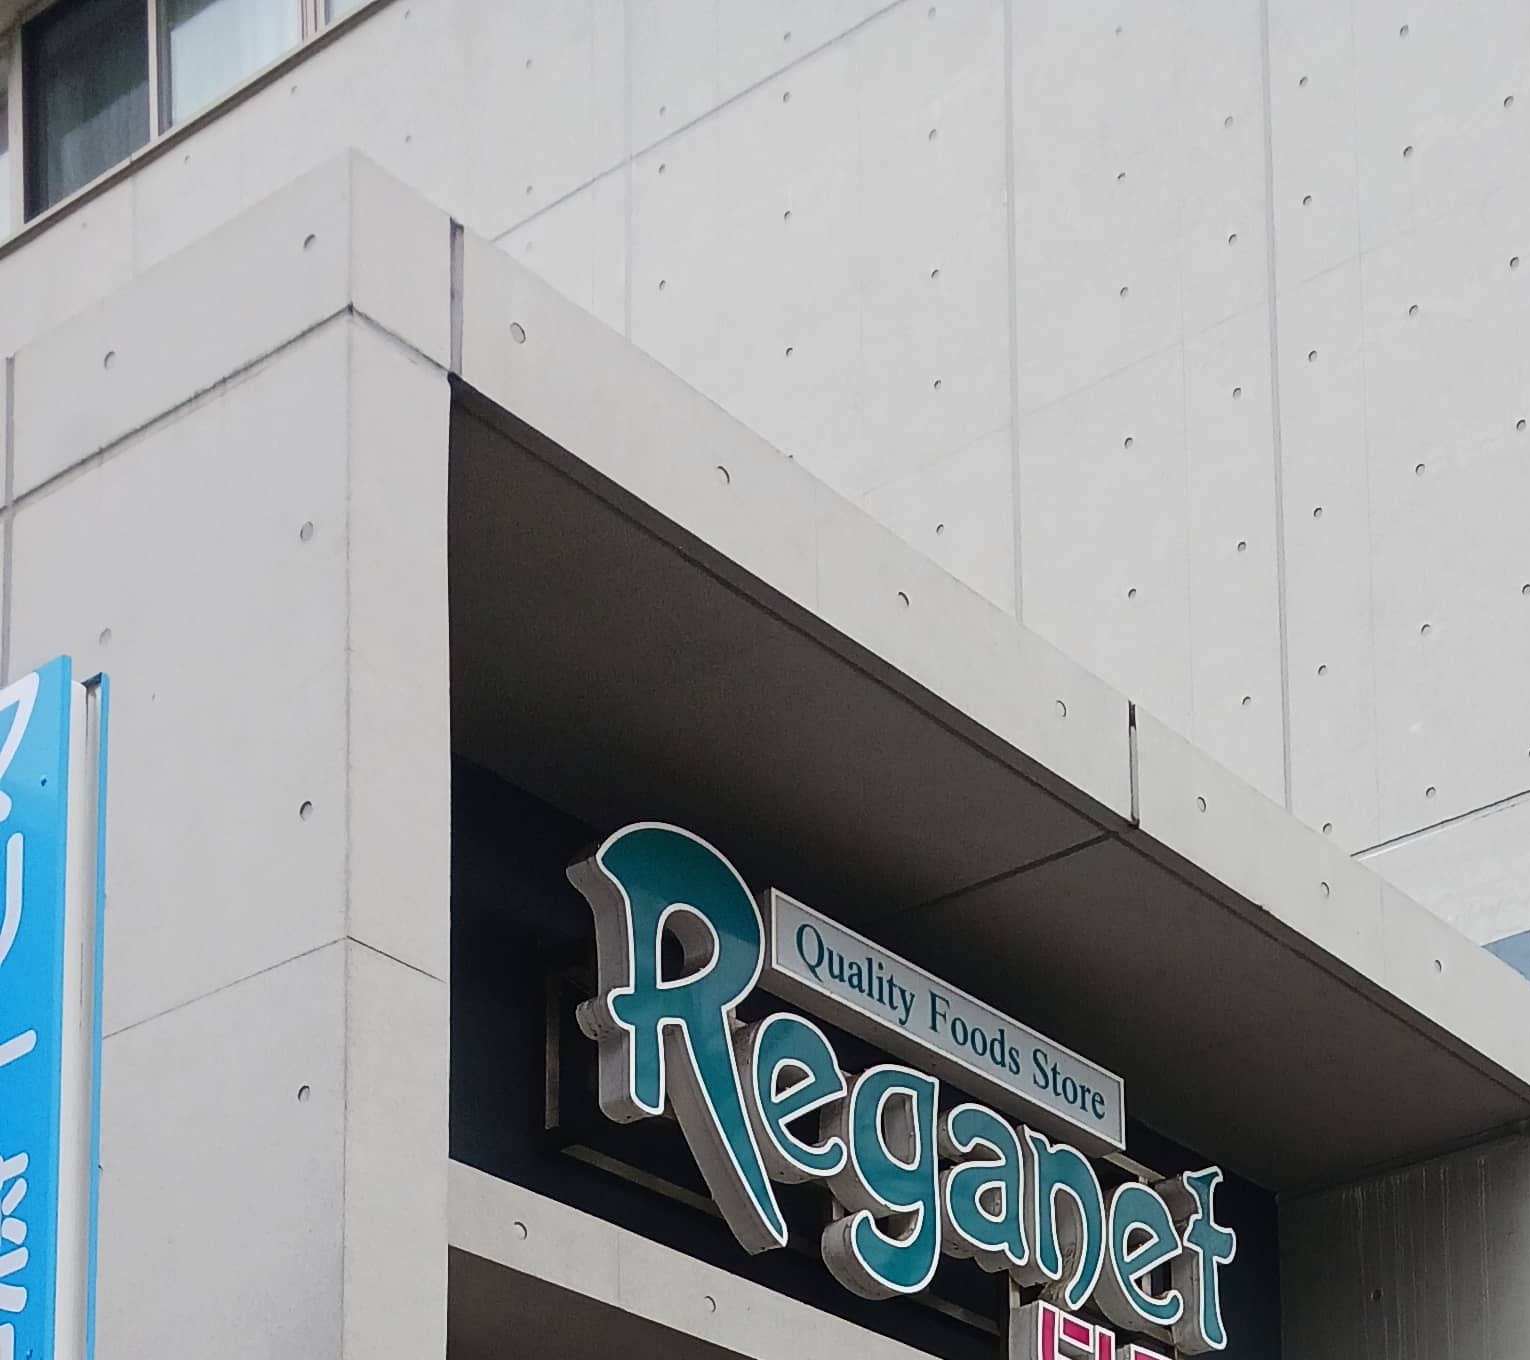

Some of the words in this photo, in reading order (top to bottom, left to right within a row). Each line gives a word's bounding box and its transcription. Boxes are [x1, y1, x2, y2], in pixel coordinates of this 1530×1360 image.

[597, 821, 1237, 1350] Reganet
[795, 922, 916, 1026] Quality
[927, 990, 1021, 1076] Foods
[1031, 1046, 1107, 1121] Store
